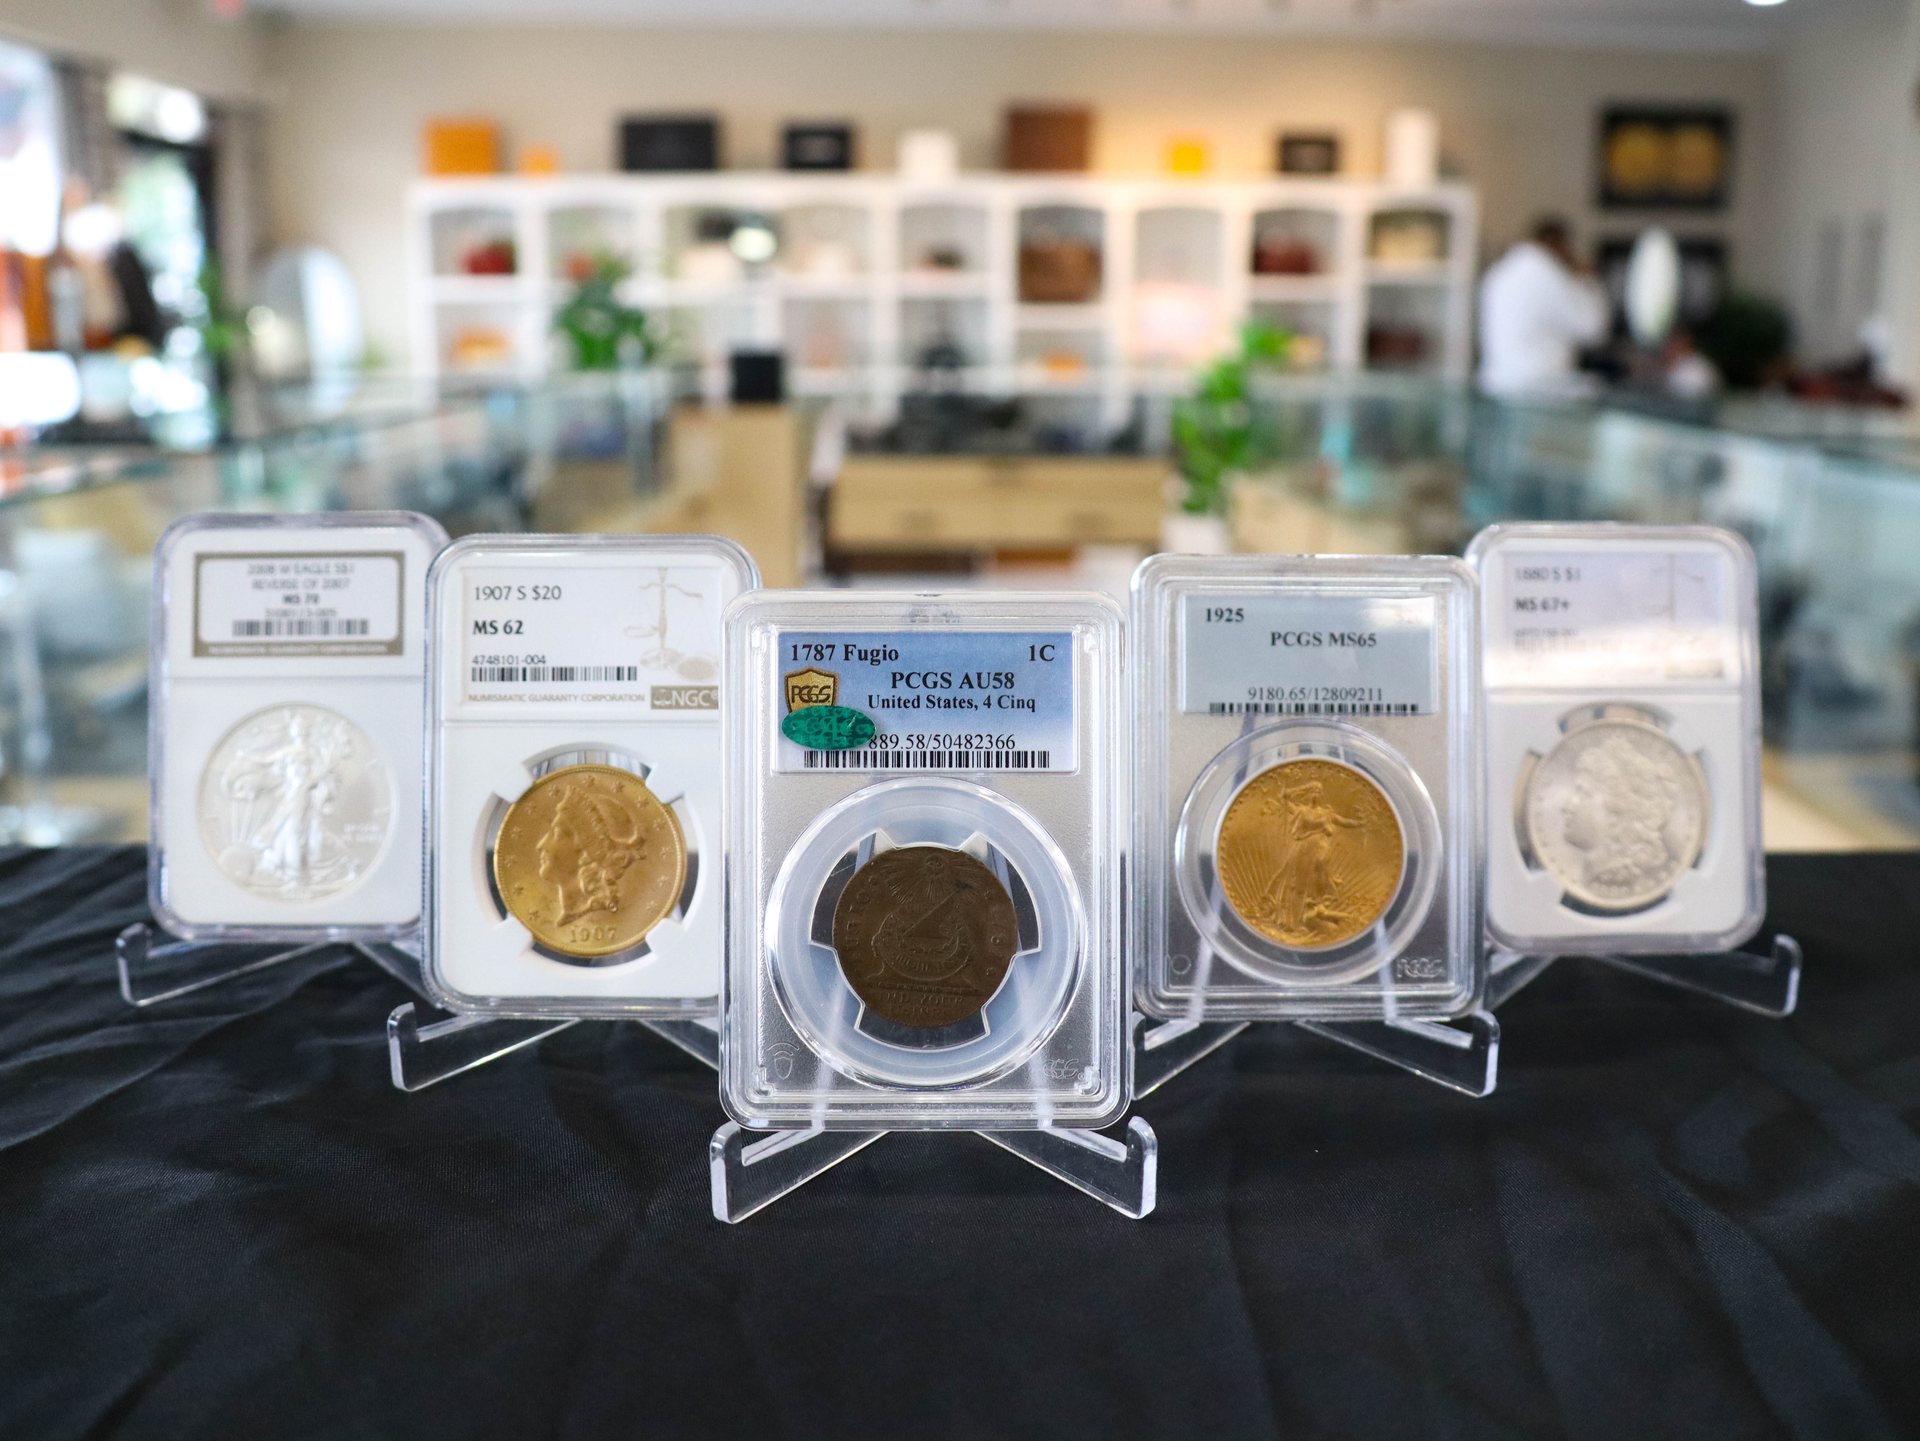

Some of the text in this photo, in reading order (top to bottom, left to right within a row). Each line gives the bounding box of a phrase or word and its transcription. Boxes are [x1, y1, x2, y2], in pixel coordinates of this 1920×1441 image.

[475, 585, 562, 601] 1907 S $20
[1514, 597, 1538, 611] MS
[1205, 608, 1245, 622] 1925
[472, 620, 524, 635] MS 62
[1270, 631, 1377, 647] PCGS MS65
[472, 655, 546, 665] 4748101-004
[791, 644, 1056, 666] 1787 Fugio 1C
[891, 672, 1015, 689] PCGS AU58
[468, 694, 645, 702] NUMISMATIC GUARANTY CORPORATION
[672, 689, 711, 707] NGC
[791, 685, 831, 703] PCGS
[1248, 686, 1383, 702] 9180.65/12809211
[868, 694, 1036, 713] United States, 4 Cinq
[868, 734, 1016, 750] 889.58/50482366
[570, 927, 617, 943] 1907
